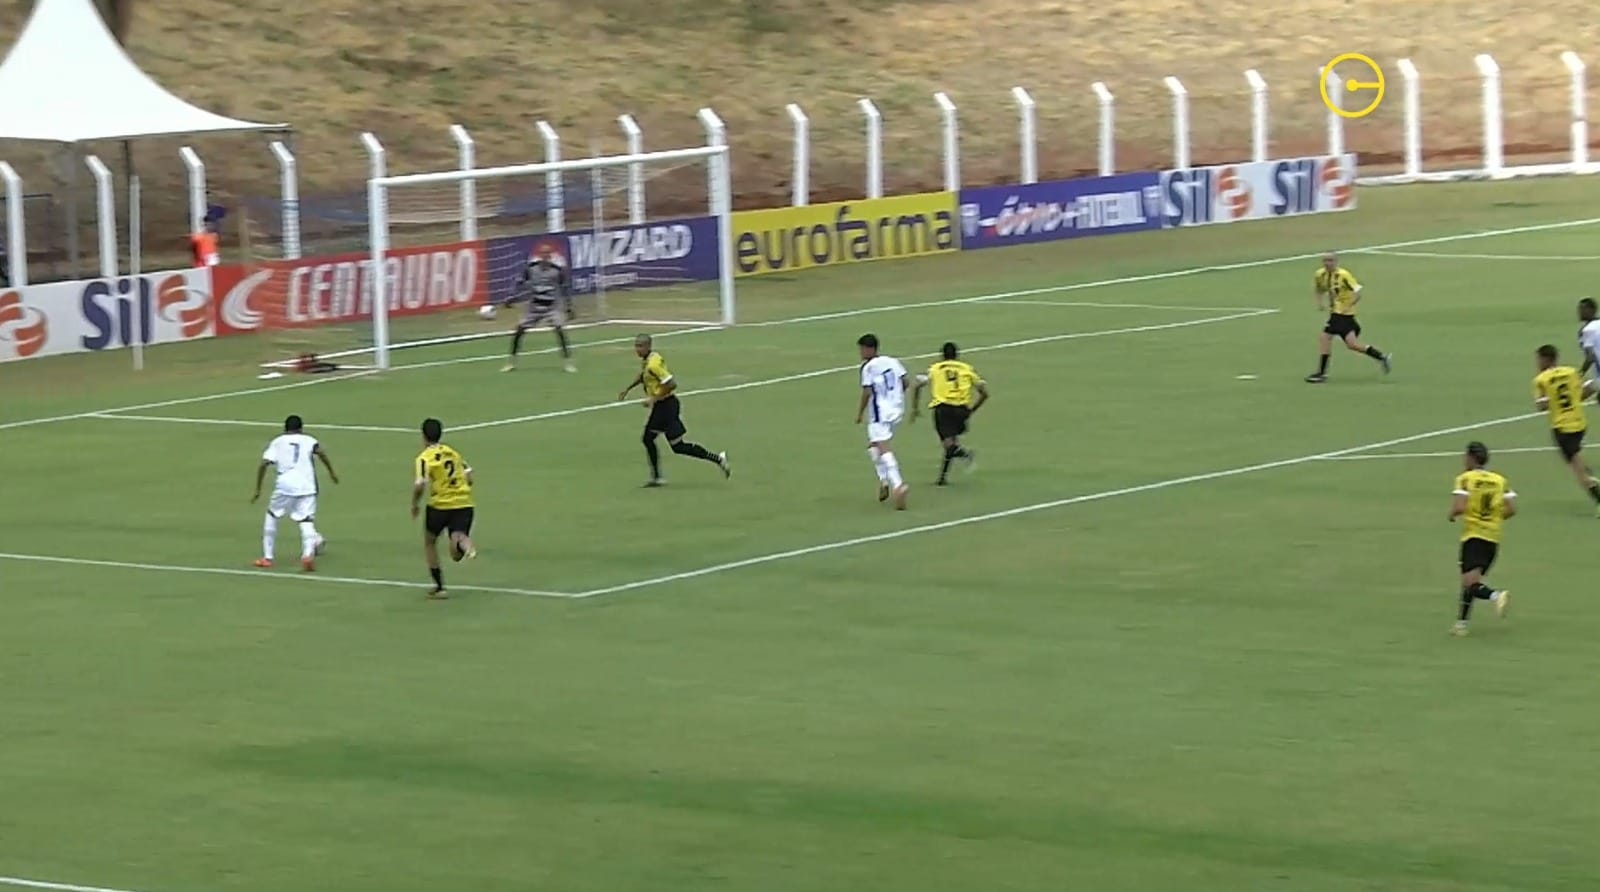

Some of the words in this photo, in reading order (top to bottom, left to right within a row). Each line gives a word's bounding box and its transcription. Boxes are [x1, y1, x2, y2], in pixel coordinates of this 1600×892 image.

[1168, 168, 1212, 226] Sil
[1273, 158, 1316, 215] Sil
[568, 224, 692, 269] WIZARD
[736, 204, 953, 272] eurofarma
[82, 277, 152, 350] Sil
[288, 248, 478, 322] CENTAURO
[289, 443, 300, 463] 7
